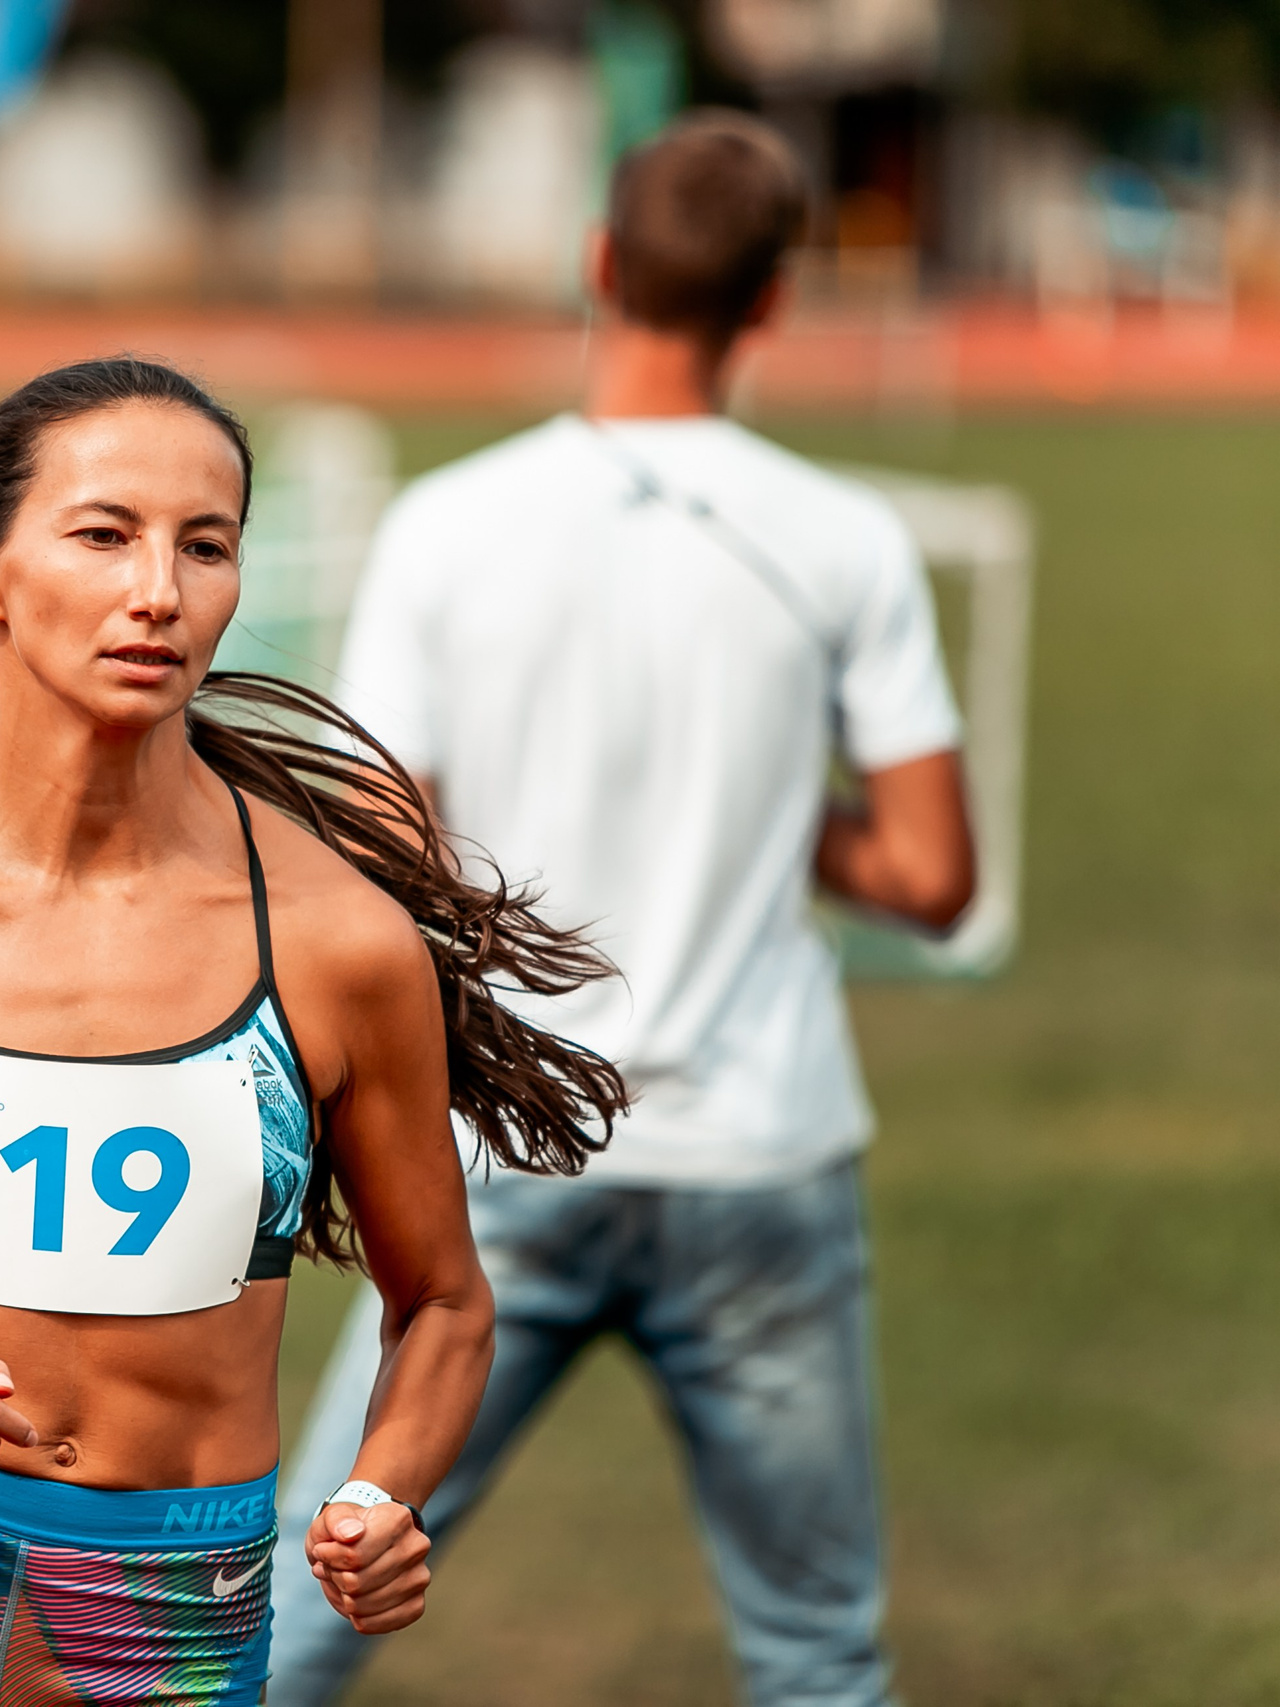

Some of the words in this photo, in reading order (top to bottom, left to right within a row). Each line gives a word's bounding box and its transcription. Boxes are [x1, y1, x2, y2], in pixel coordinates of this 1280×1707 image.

[256, 1078, 283, 1090] ebok
[0, 1125, 191, 1256] 19
[161, 1492, 266, 1534] NIKE
